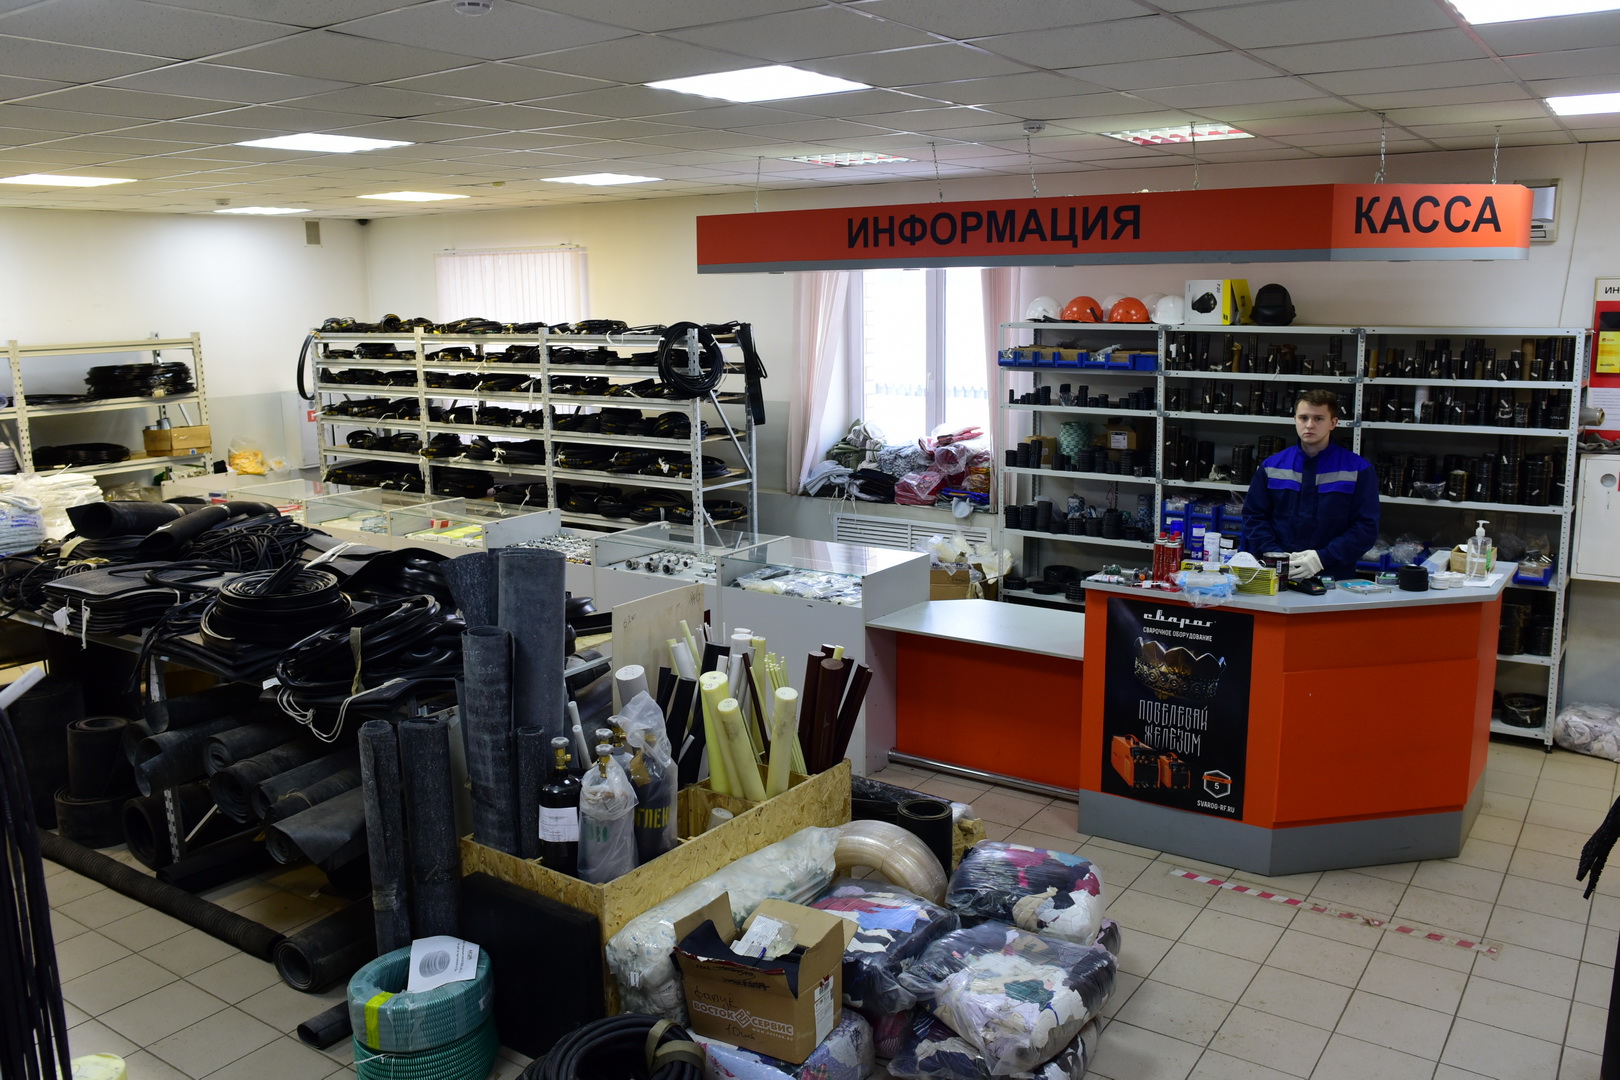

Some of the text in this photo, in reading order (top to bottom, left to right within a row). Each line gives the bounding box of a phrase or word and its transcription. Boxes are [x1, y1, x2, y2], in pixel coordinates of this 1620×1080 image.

[847, 205, 1141, 248] ИНФОРМАЦИЯ
[1355, 195, 1501, 234] КАССА
[1143, 626, 1213, 642] СВАРОЧНОЕ ОБОРУДОВАНИЕ
[1138, 699, 1208, 731] ПОВЕЛЕВАЙ
[1144, 724, 1201, 757] ЖЕЛЕЗОМ
[1214, 782, 1220, 790] 5
[1197, 799, 1236, 813] SVAROG-RF.RU
[692, 1001, 794, 1036] ВОСТОК СЕРВИС
